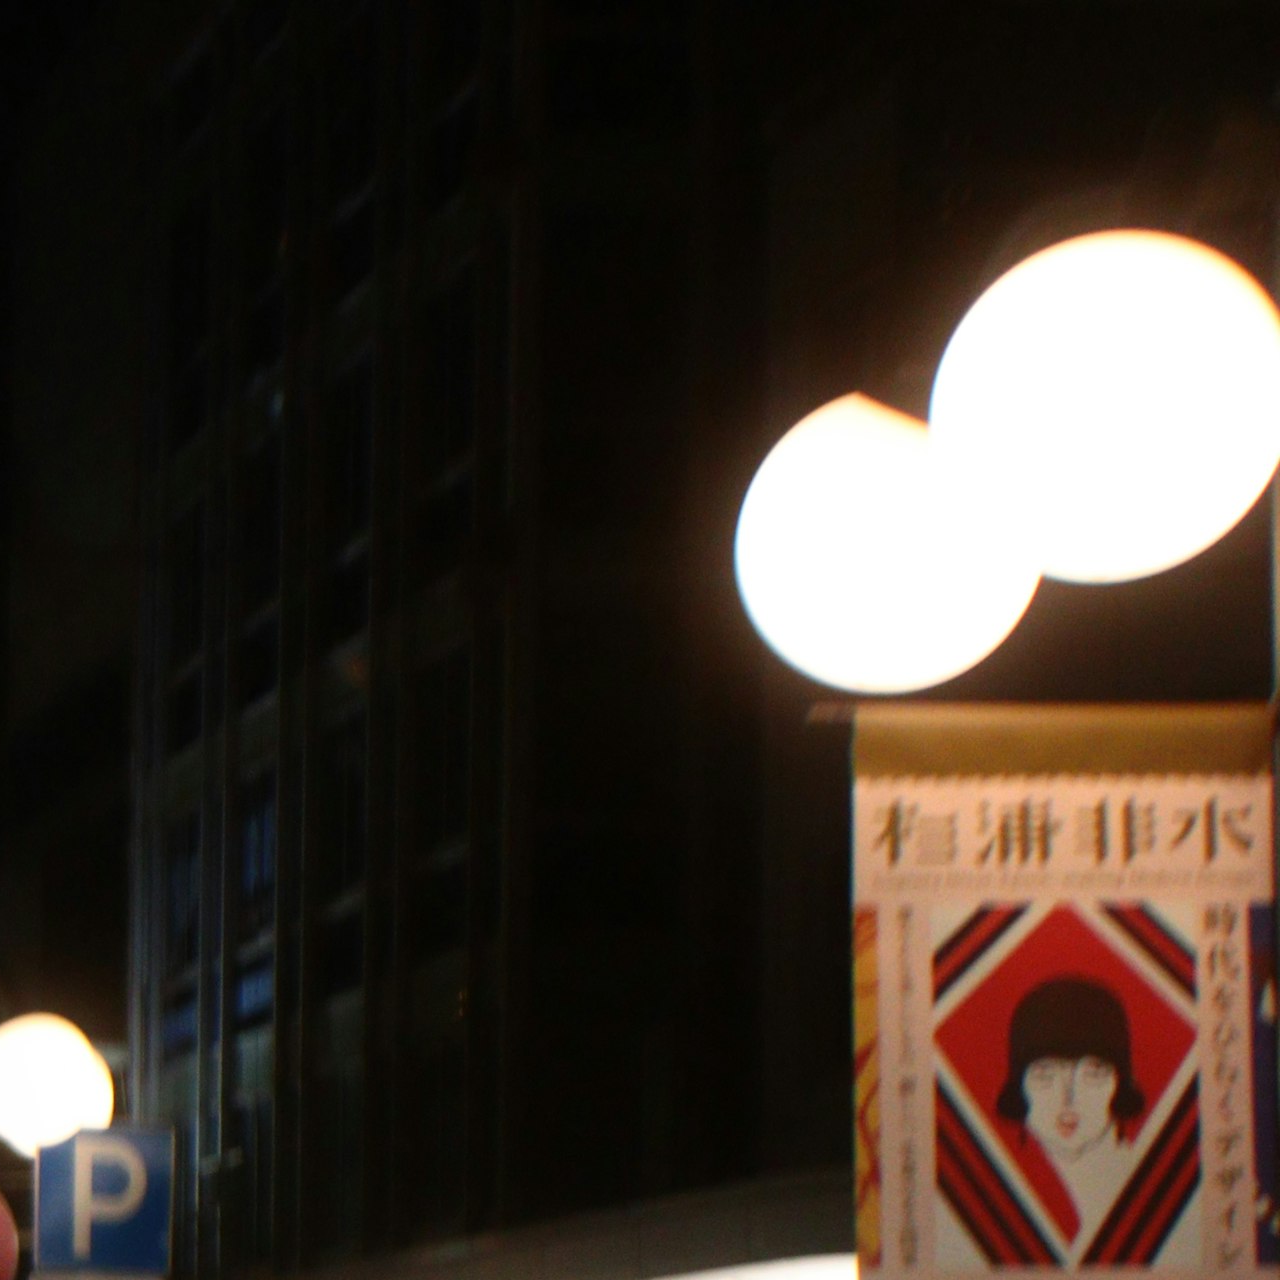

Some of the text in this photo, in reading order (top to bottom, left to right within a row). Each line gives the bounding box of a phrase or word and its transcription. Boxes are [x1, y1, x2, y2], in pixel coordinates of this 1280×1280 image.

[874, 794, 1253, 866] 杉浦非水
[73, 1133, 147, 1260] P
